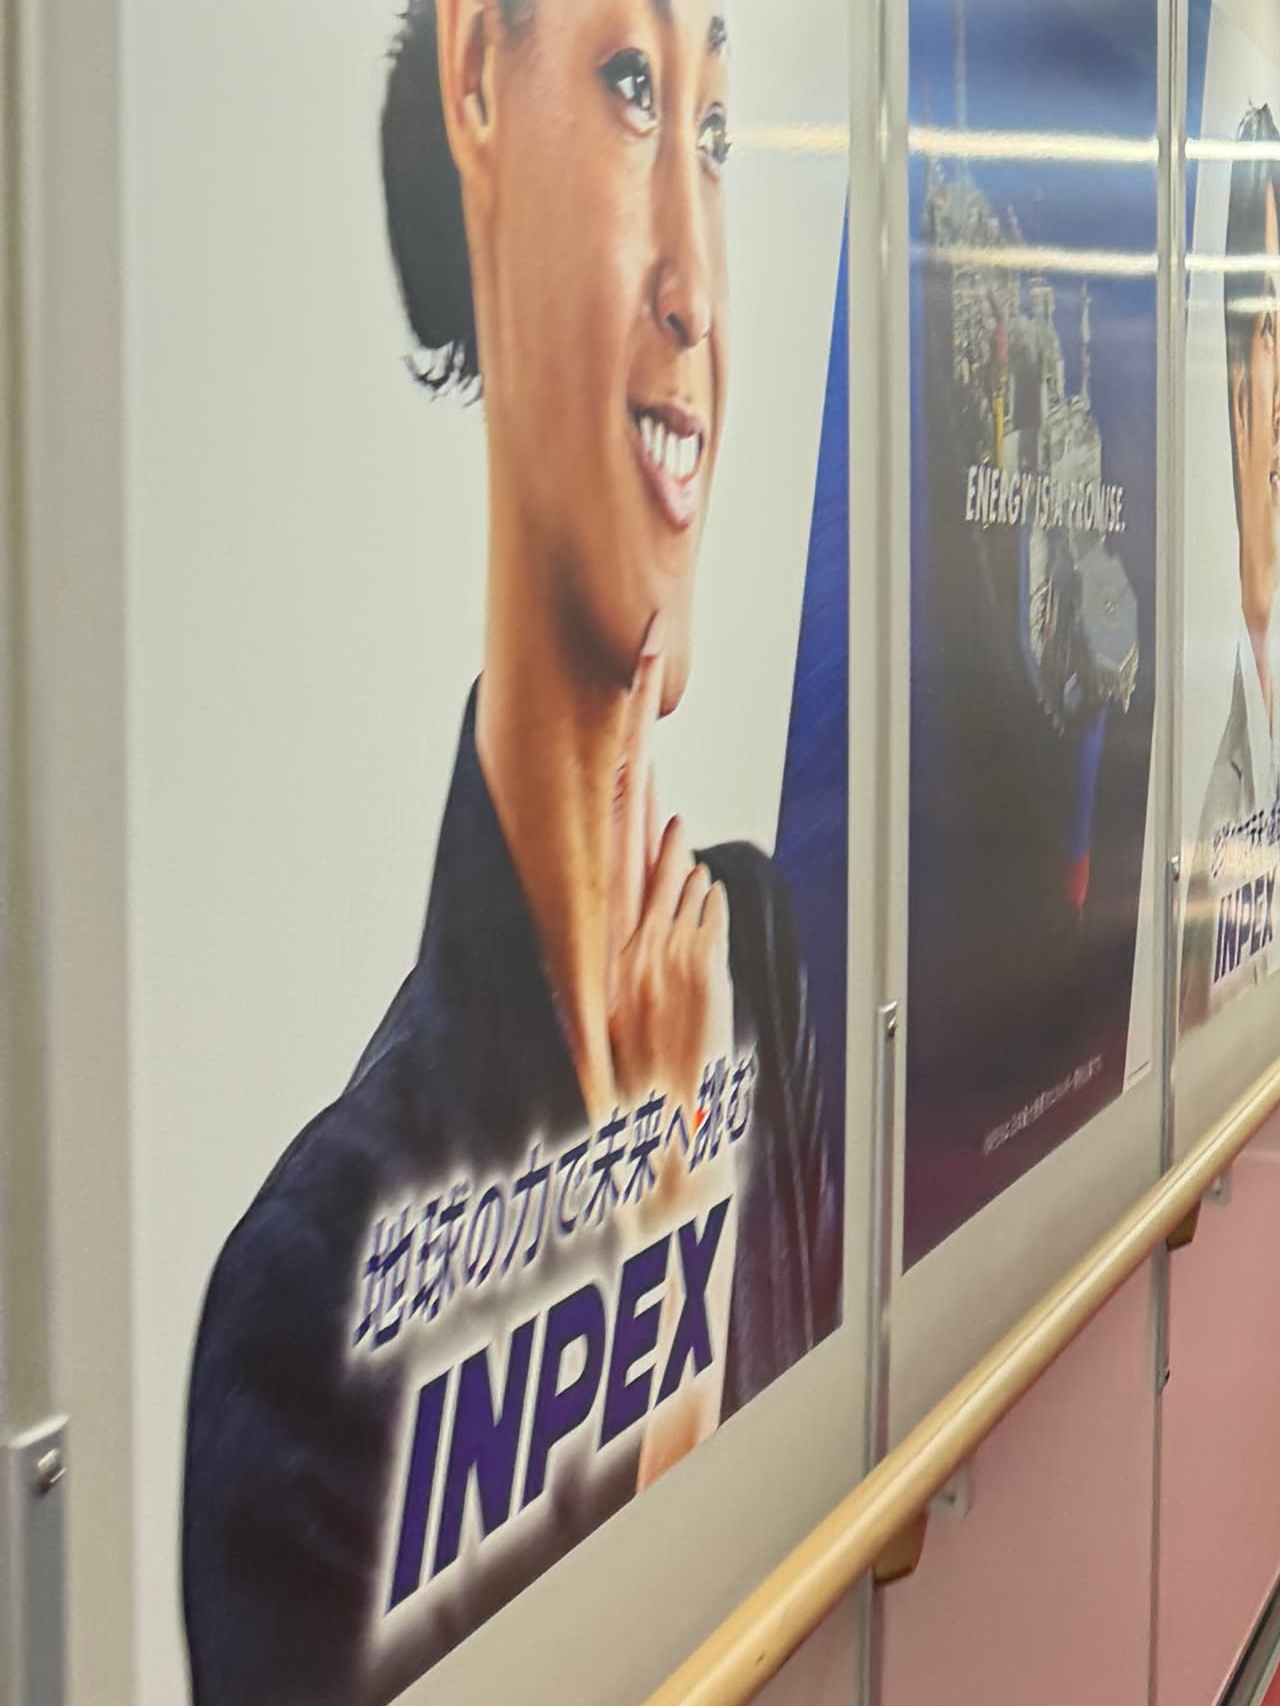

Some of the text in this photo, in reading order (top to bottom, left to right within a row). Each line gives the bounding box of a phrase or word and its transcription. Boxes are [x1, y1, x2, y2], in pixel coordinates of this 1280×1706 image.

[966, 465, 1031, 527] ENERGY
[1214, 864, 1278, 983] INPEX
[353, 1050, 757, 1349] 地球の力で未来へ挑む
[385, 1194, 733, 1616] INPEX
